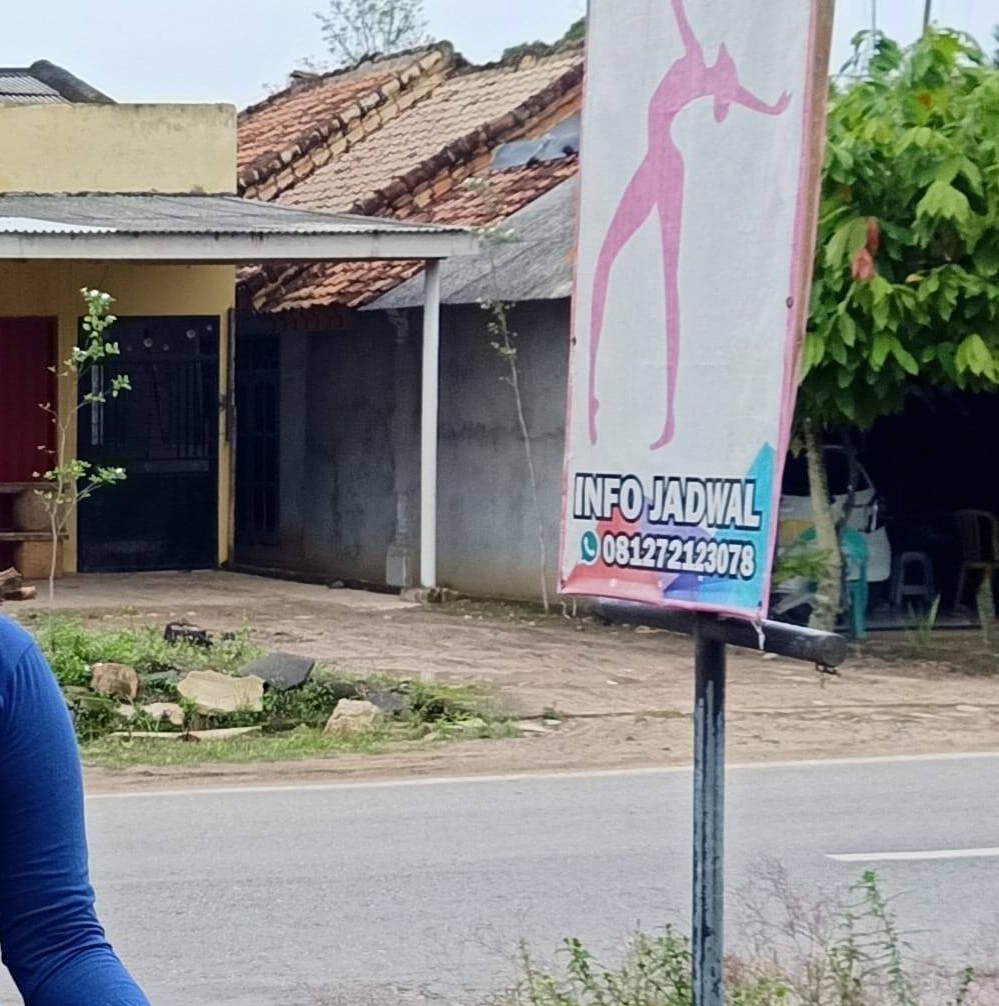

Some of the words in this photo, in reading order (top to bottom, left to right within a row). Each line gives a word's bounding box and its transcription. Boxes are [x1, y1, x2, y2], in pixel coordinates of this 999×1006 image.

[573, 473, 644, 522] INFO
[648, 475, 762, 530] JADWAL
[601, 531, 757, 580] 081272123078
